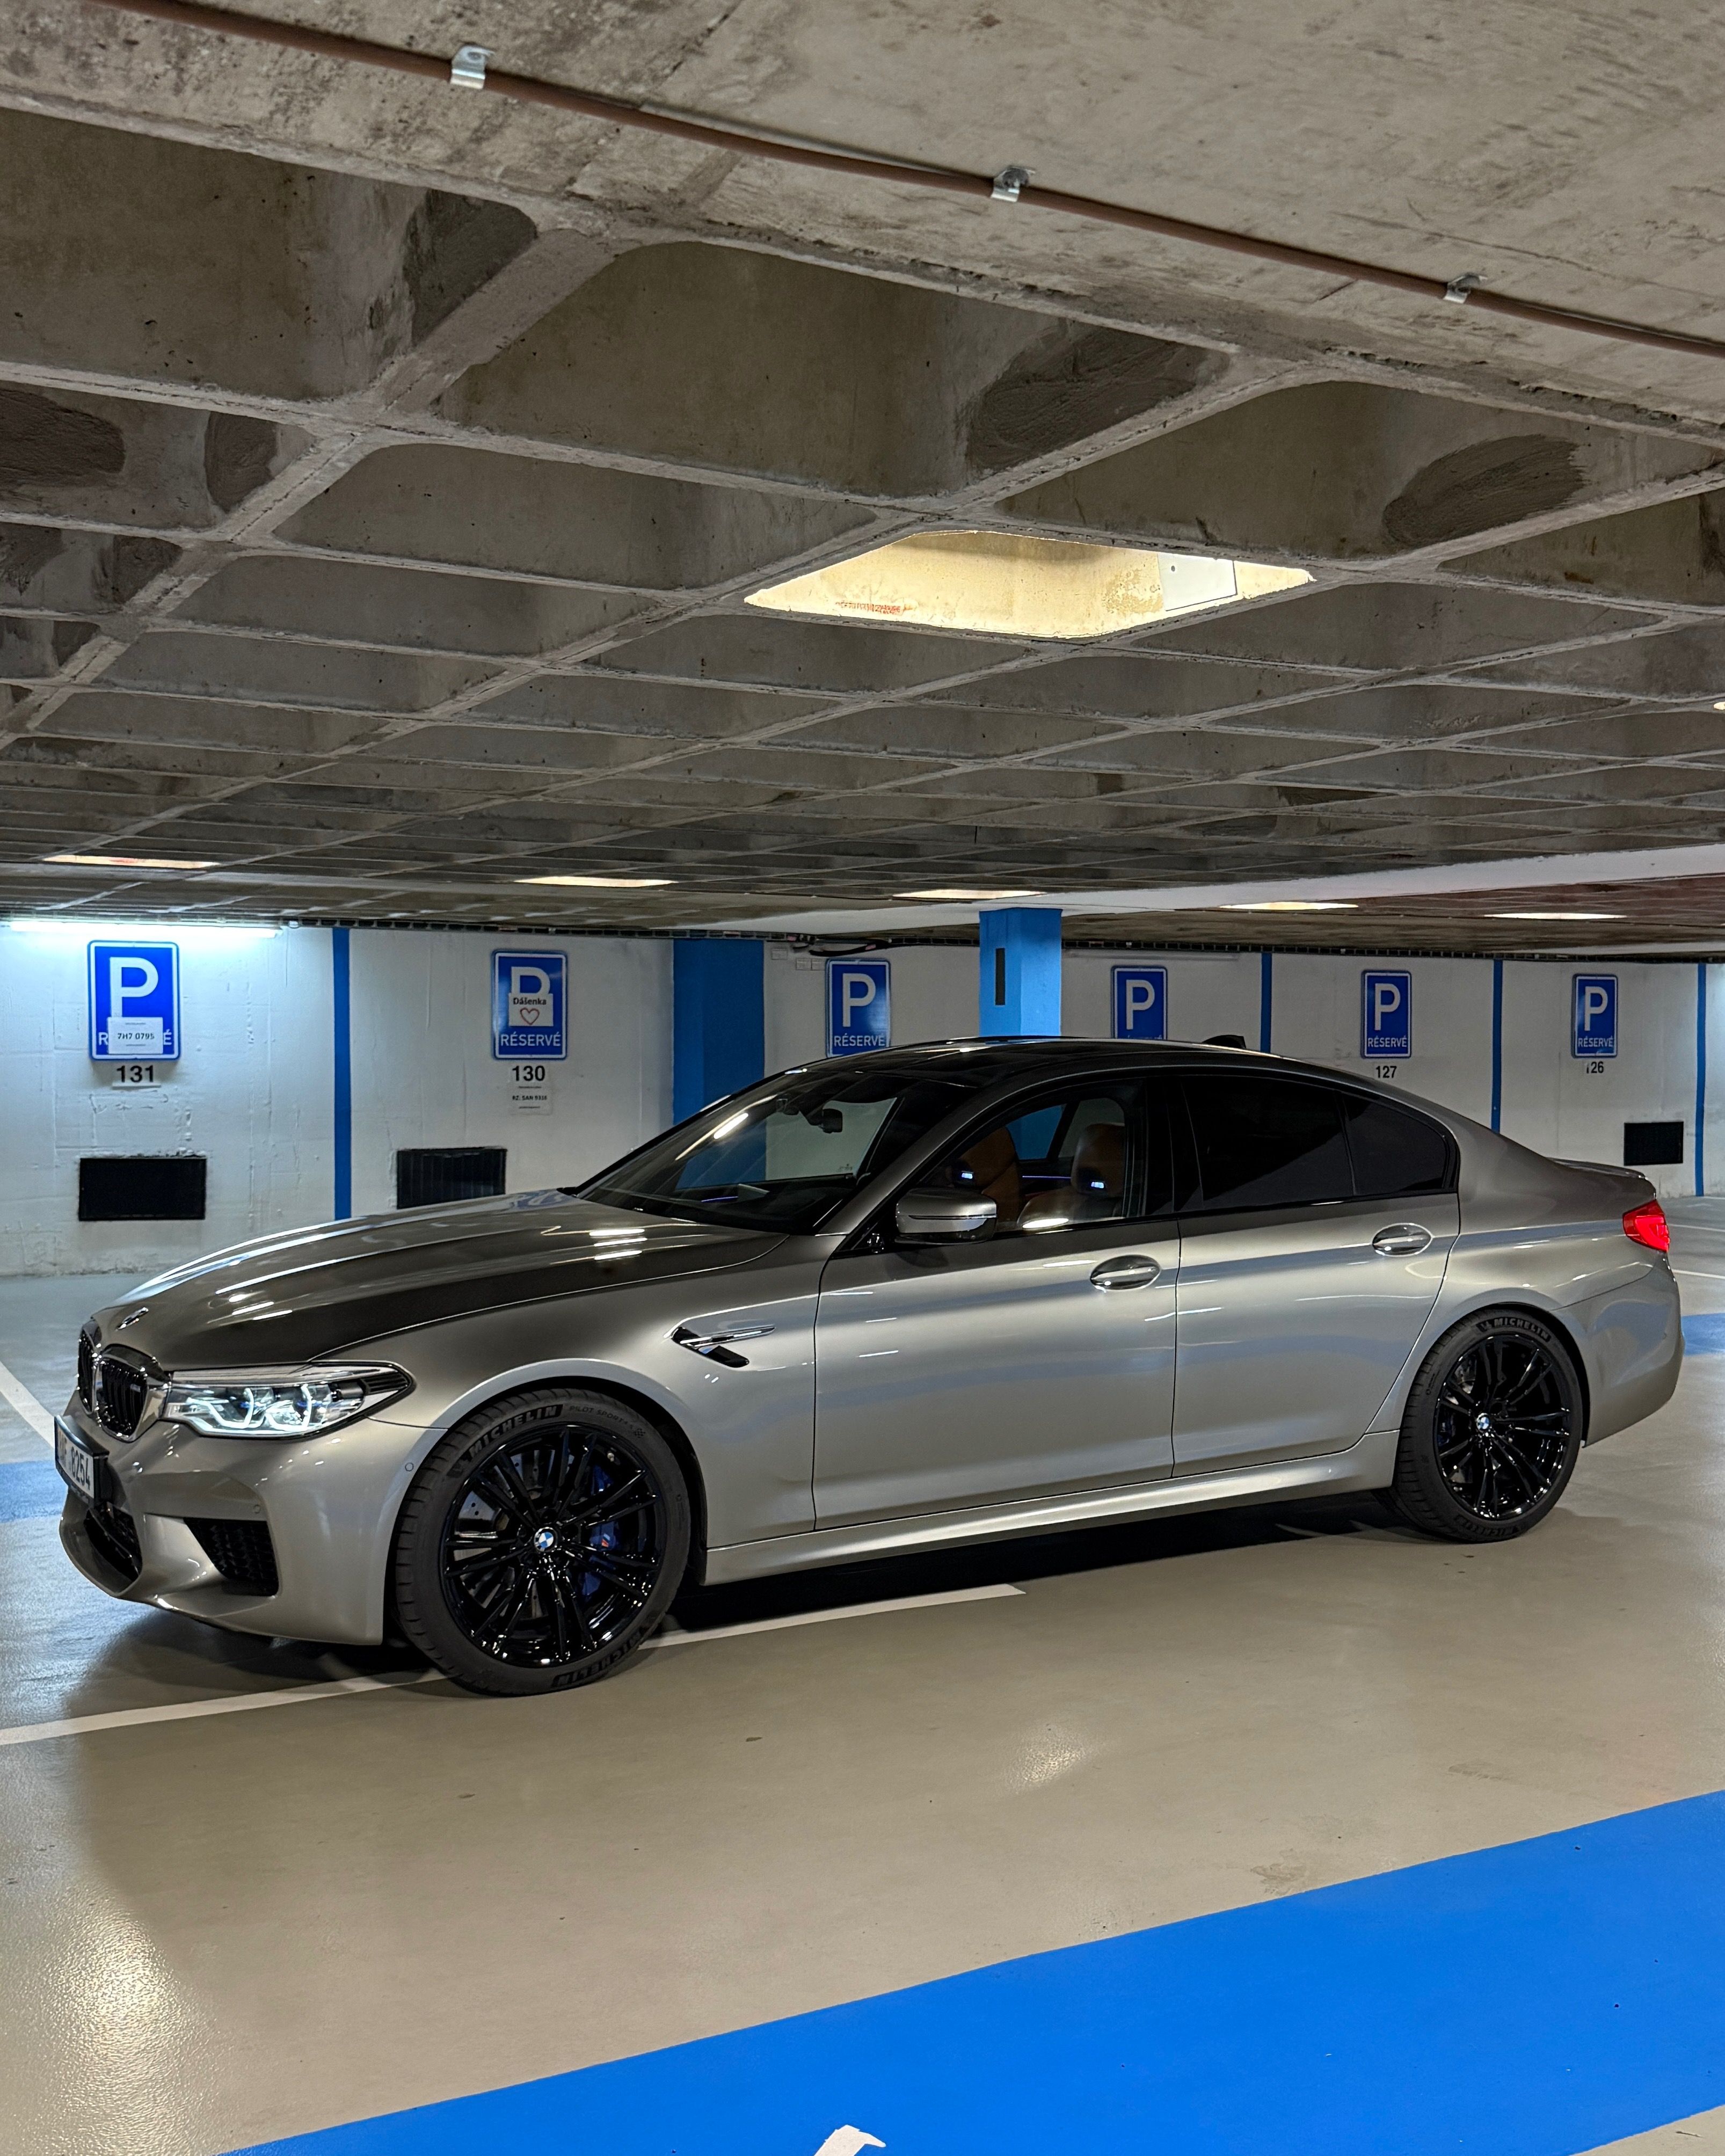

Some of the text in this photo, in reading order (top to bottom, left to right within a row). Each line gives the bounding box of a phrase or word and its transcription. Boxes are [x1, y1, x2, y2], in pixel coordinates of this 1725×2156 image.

[110, 957, 159, 1017] P
[513, 997, 547, 1006] Dášenka
[842, 973, 876, 1028] P
[1126, 979, 1155, 1030] P
[1374, 983, 1401, 1031] P
[1584, 986, 1608, 1031] P
[500, 1031, 561, 1046] RÉSERVÉ
[834, 1033, 885, 1046] RÉSERVÉ
[1368, 1035, 1407, 1047] RÉSERVÉ
[1578, 1036, 1613, 1047] RÉSERVÉ
[117, 1065, 154, 1082] 131
[512, 1065, 545, 1082] 130
[1375, 1066, 1397, 1078] 127
[1494, 1317, 1548, 1341] MICHELIN
[469, 1404, 559, 1458] MICHELIN
[596, 1409, 623, 1422] SPORT
[71, 1446, 90, 1490] 8254
